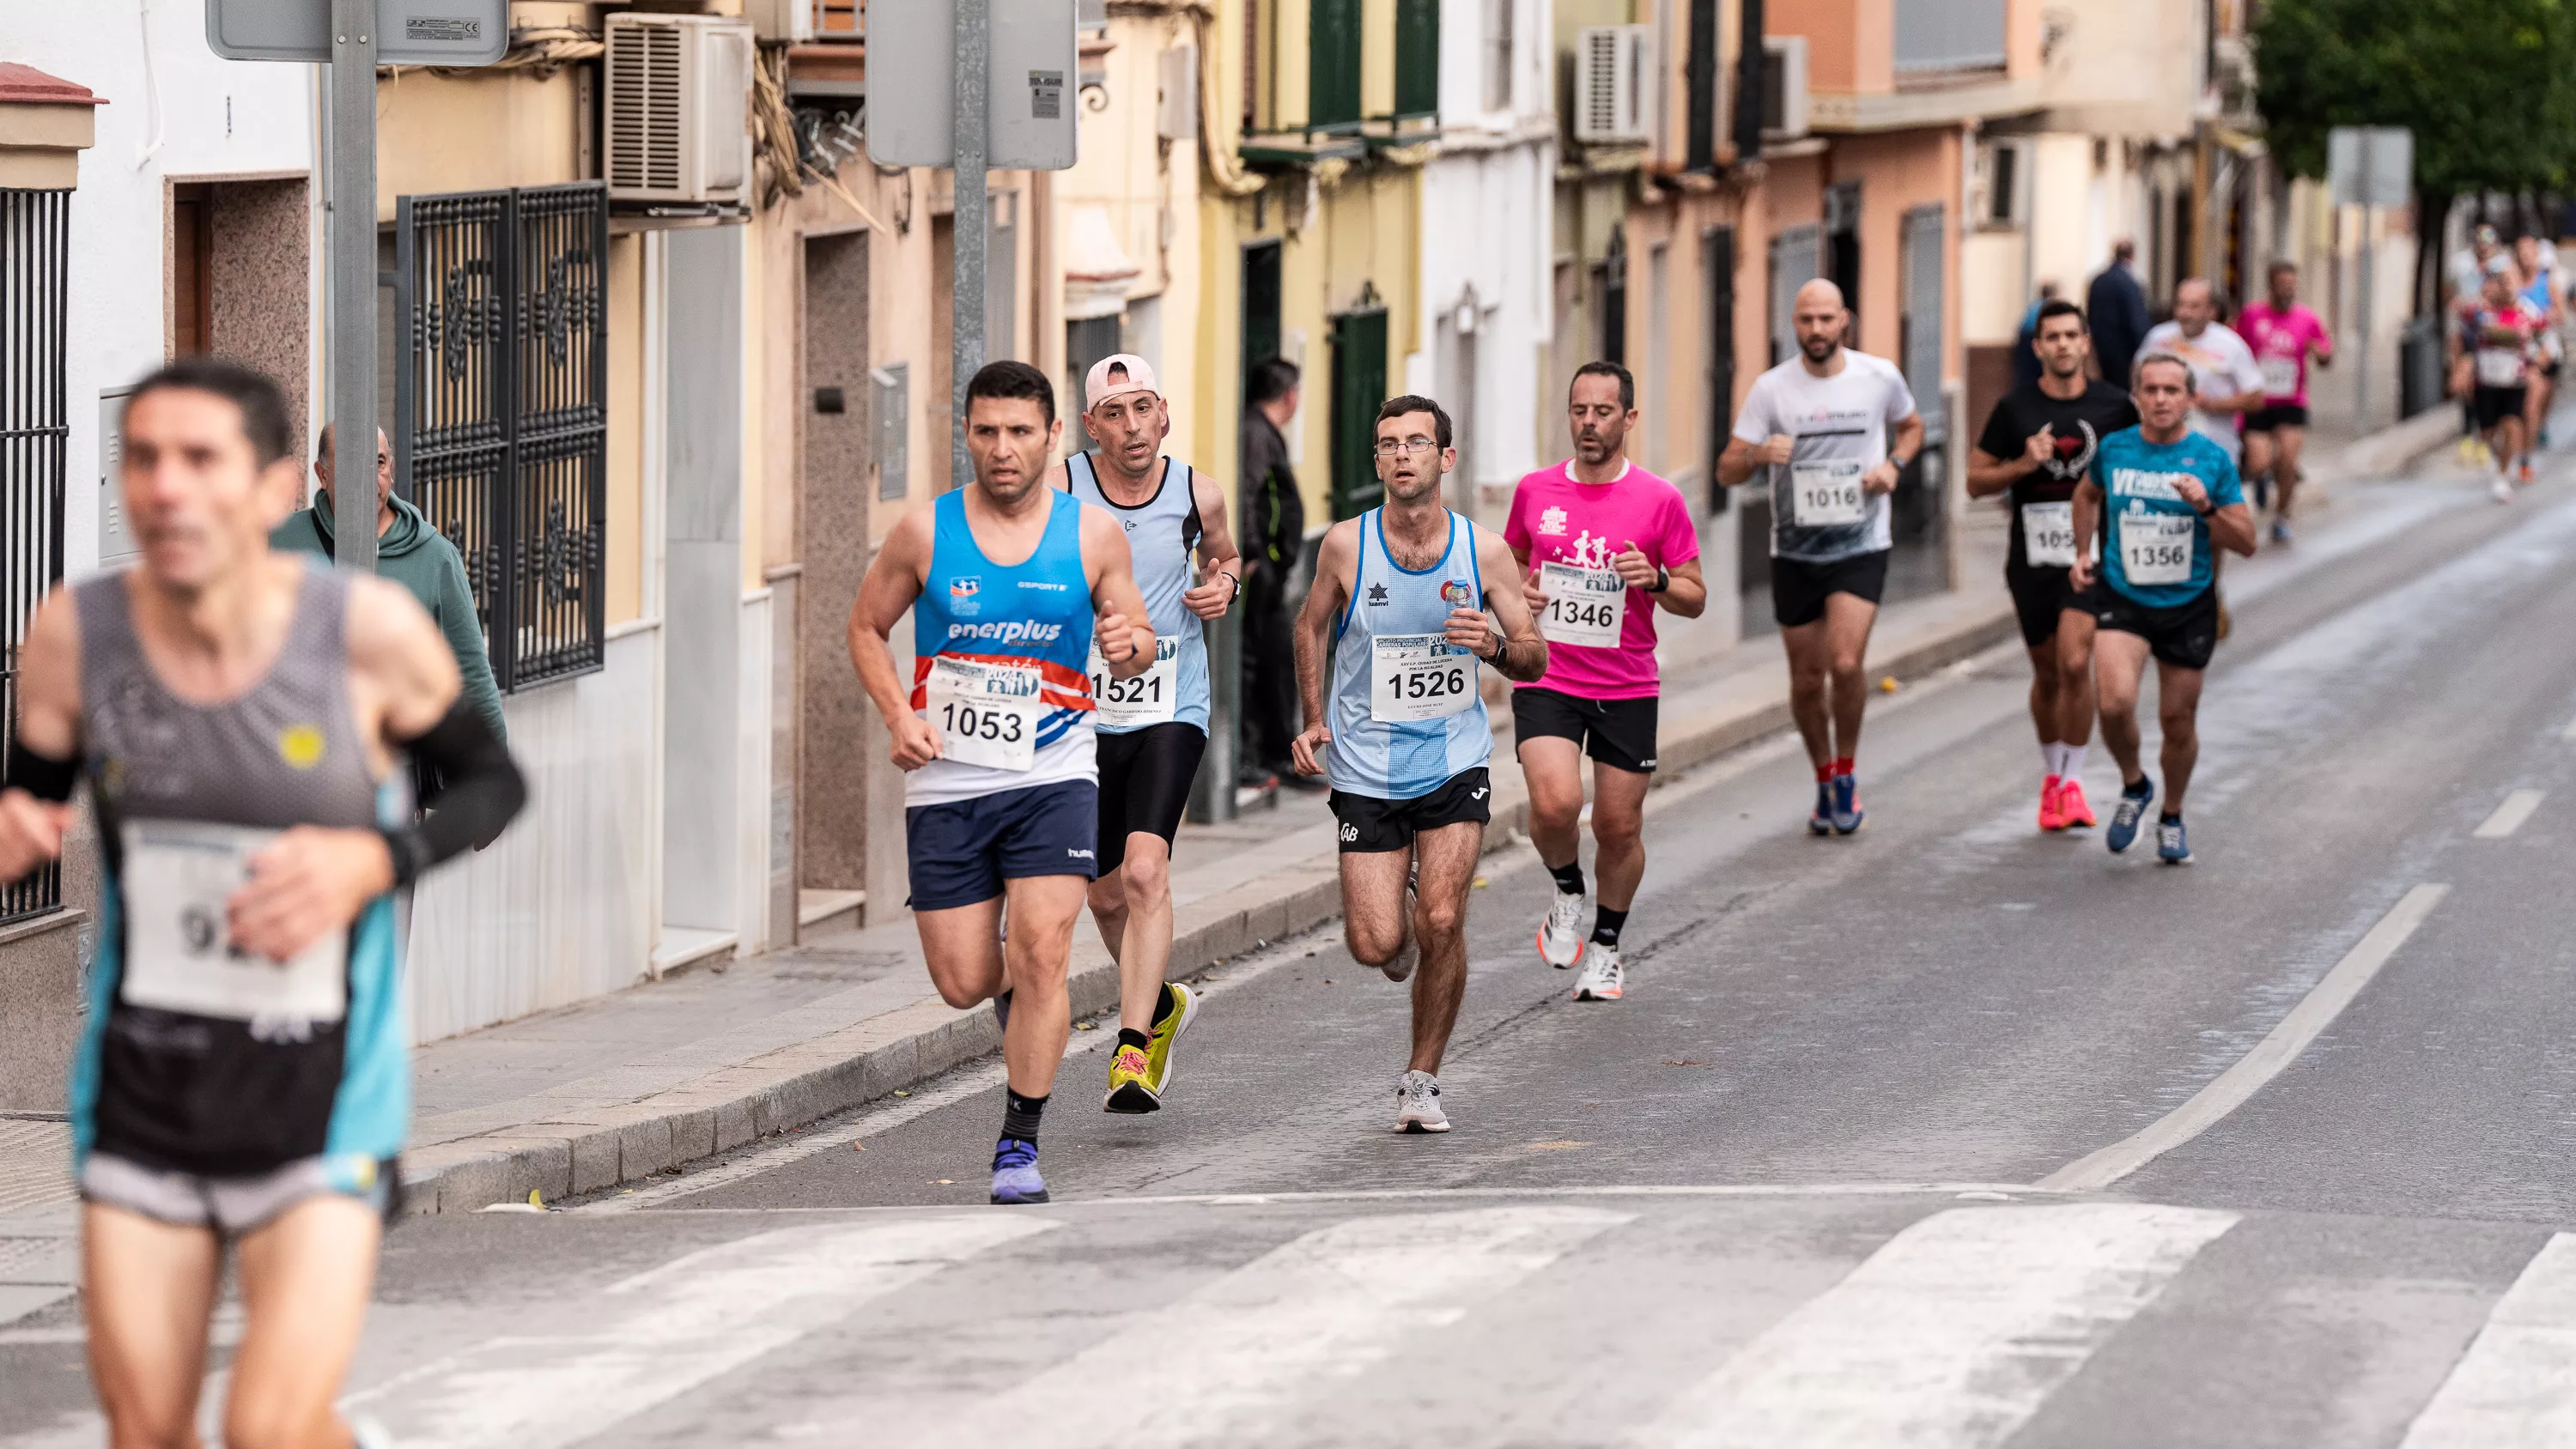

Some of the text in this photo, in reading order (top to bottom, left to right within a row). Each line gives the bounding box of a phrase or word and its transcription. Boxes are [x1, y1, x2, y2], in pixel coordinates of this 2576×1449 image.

[1805, 486, 1857, 509] 1016
[2130, 545, 2185, 566] 1356
[1550, 598, 1613, 627] 1346
[949, 619, 1062, 645] enerplus
[1092, 673, 1161, 703] 1521
[1388, 668, 1465, 700] 1526
[943, 702, 1022, 743] 1053
